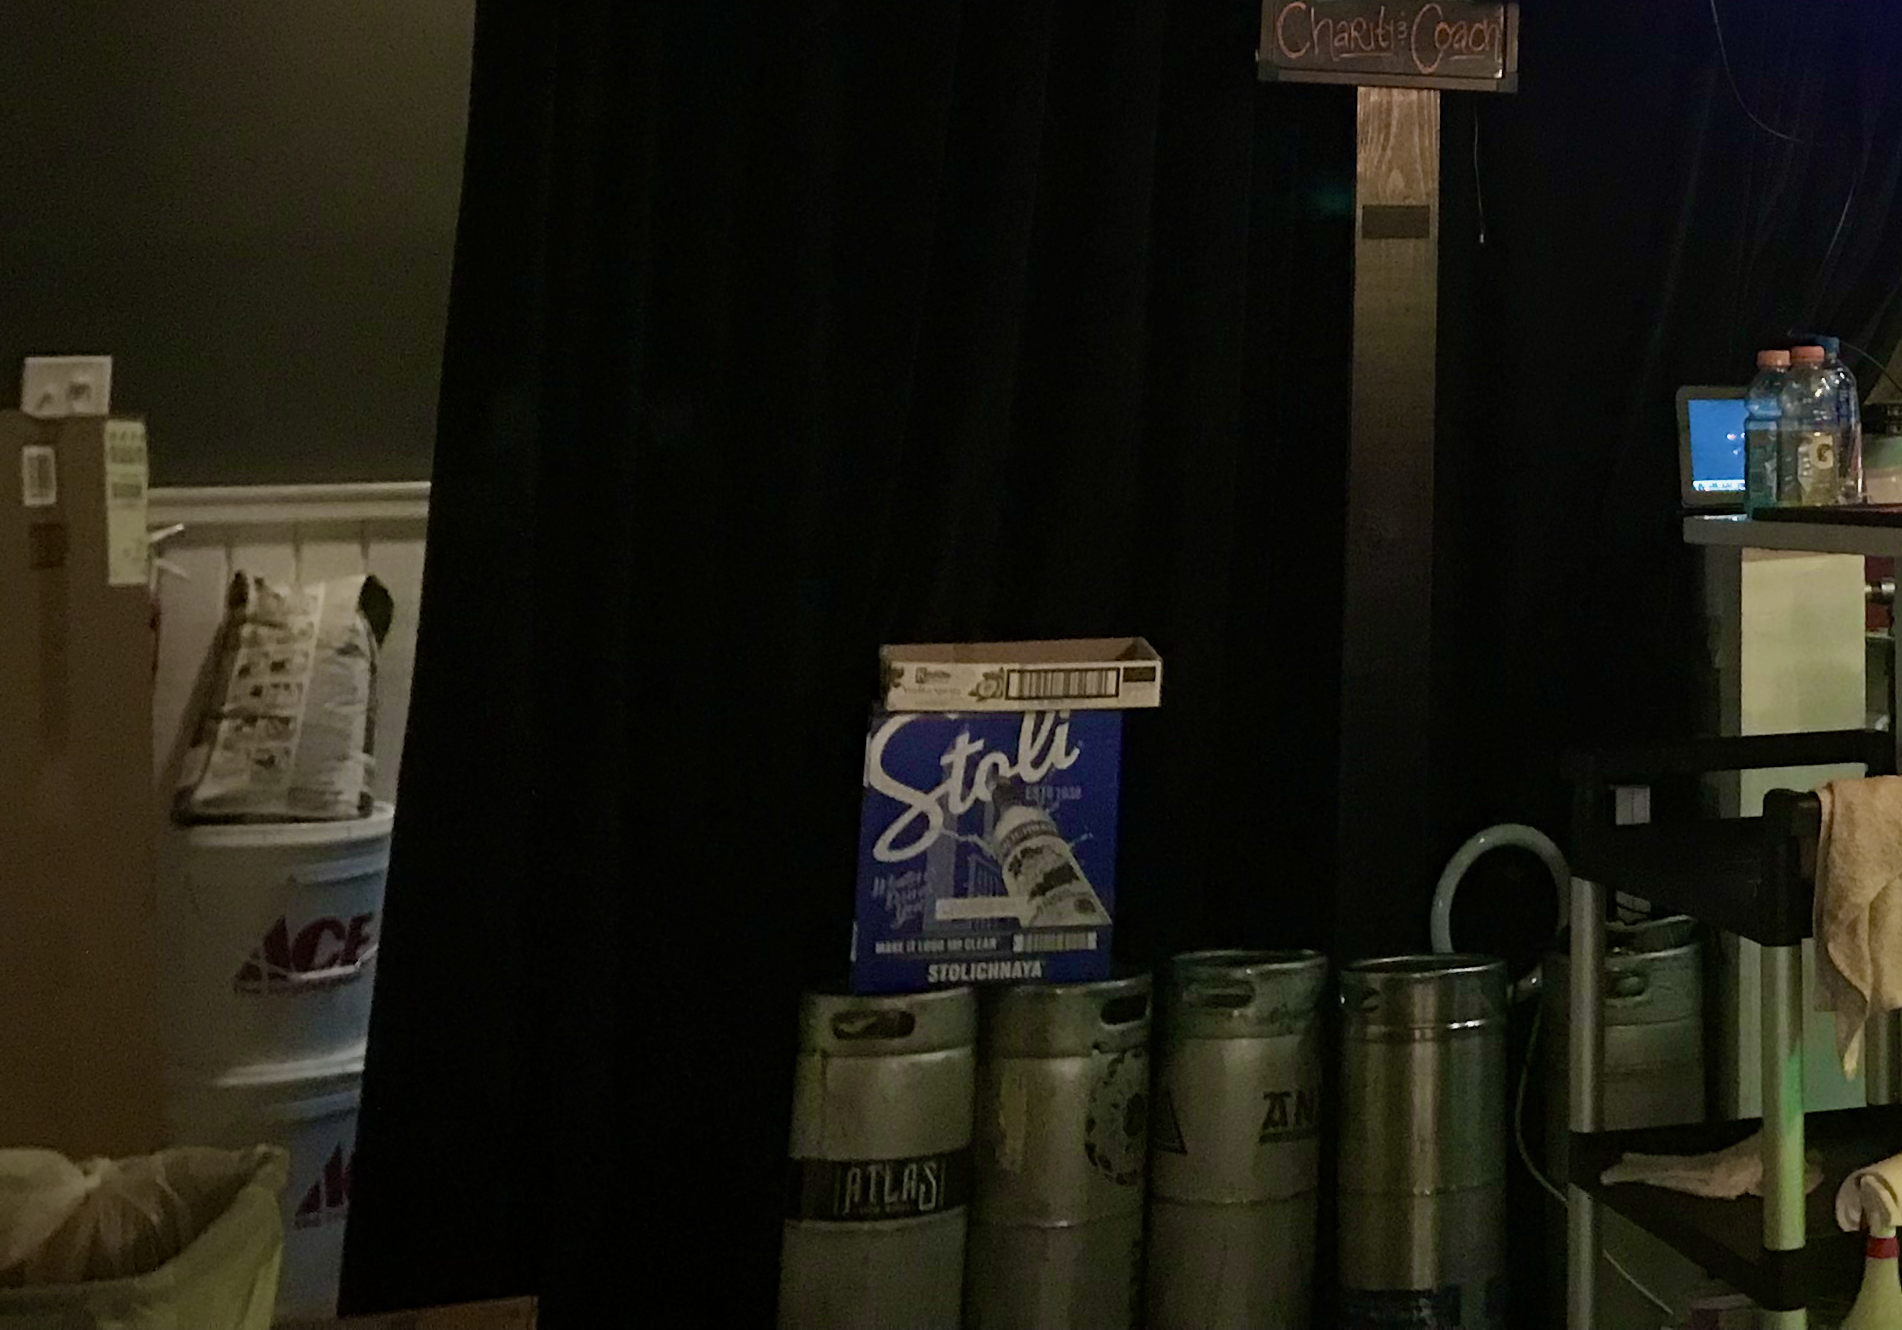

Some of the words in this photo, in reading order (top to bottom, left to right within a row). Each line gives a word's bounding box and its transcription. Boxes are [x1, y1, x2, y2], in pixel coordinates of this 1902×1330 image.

[868, 710, 1081, 863] Stoli
[927, 959, 1043, 985] STOLICHNAYA
[843, 1160, 940, 1215] ATLAS
